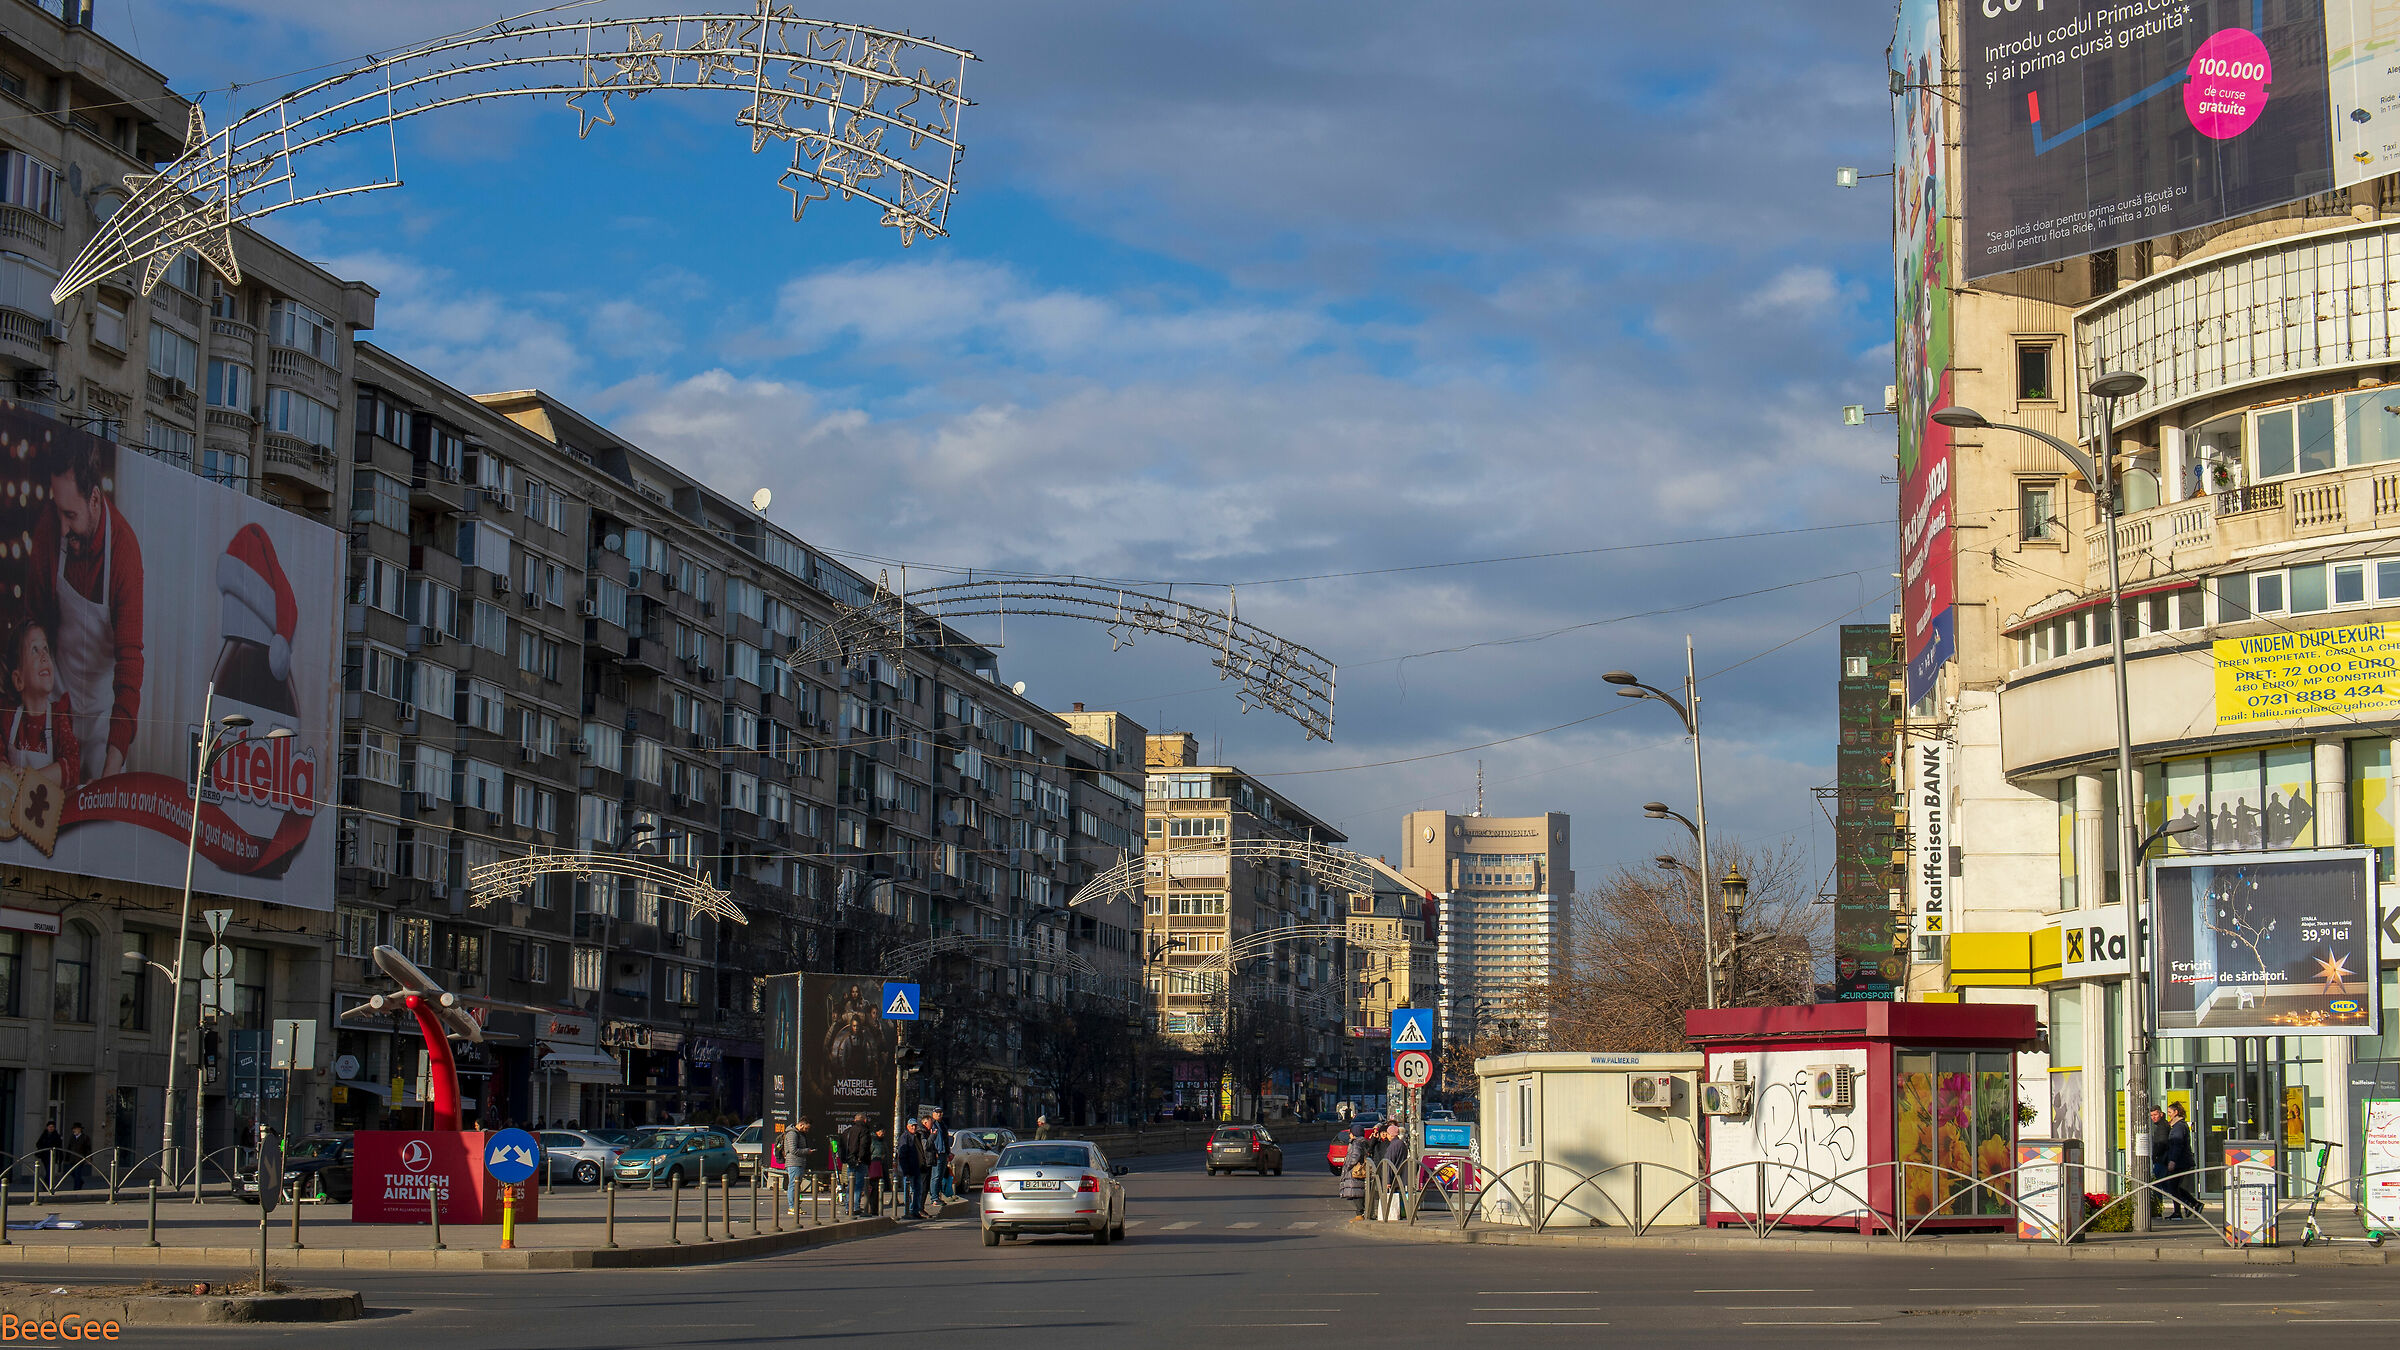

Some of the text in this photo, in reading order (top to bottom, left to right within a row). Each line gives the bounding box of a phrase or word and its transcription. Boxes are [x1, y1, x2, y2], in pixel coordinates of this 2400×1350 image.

[1985, 32, 2042, 62] Introdu
[2046, 12, 2092, 43] codul
[1986, 66, 1998, 89] și
[2002, 61, 2015, 81] ai
[2020, 50, 2066, 80] prima
[2070, 29, 2113, 60] cursă
[2199, 58, 2264, 80] 100.000
[2204, 84, 2246, 100] de curse
[2380, 94, 2396, 104] Ride
[2198, 100, 2246, 116] gratuite
[2382, 142, 2397, 152] Taxi
[2004, 222, 2030, 241] aplică
[2033, 220, 2054, 232] doar
[2056, 210, 2087, 229] pentru
[2089, 204, 2116, 220] prima
[2117, 194, 2142, 212] cursă
[2144, 186, 2174, 204] făcută
[2176, 185, 2188, 196] cu
[1986, 200, 2173, 256] cardul pentru flota Ride, în limita a 20 lei.
[2240, 624, 2386, 654] VINDEM DUPLEXURI
[2218, 658, 2250, 668] TEREN
[2326, 647, 2357, 657] CASA
[2360, 645, 2374, 653] LA
[2236, 657, 2396, 682] PRET: 72 000 EURO
[2234, 670, 2398, 692] 480 EURO/ MP CONSTRUIT
[2248, 684, 2385, 707] 0731 888 434
[2220, 711, 2248, 722] mail:
[1923, 745, 1941, 808] BANK
[78, 786, 118, 811] Crăciunul
[118, 793, 130, 808] nu
[130, 797, 136, 809] a
[138, 792, 156, 814] avut
[158, 795, 194, 832] niciodată
[204, 822, 221, 845] gust
[222, 831, 236, 850] atât
[236, 840, 244, 856] de
[246, 843, 259, 858] bun
[1924, 811, 1942, 912] Raiffeisen
[2302, 928, 2349, 942] 39,90 lei
[2172, 960, 2212, 972] Fericiți
[2220, 972, 2233, 982] de
[2236, 970, 2288, 982] sărbători.
[1845, 992, 1894, 1000] EUROSPORT
[1404, 1060, 1424, 1078] 60
[833, 1085, 878, 1096] ÎNTUNECATE
[837, 1080, 874, 1088] MATERIILE
[384, 1174, 450, 1187] TURKISH
